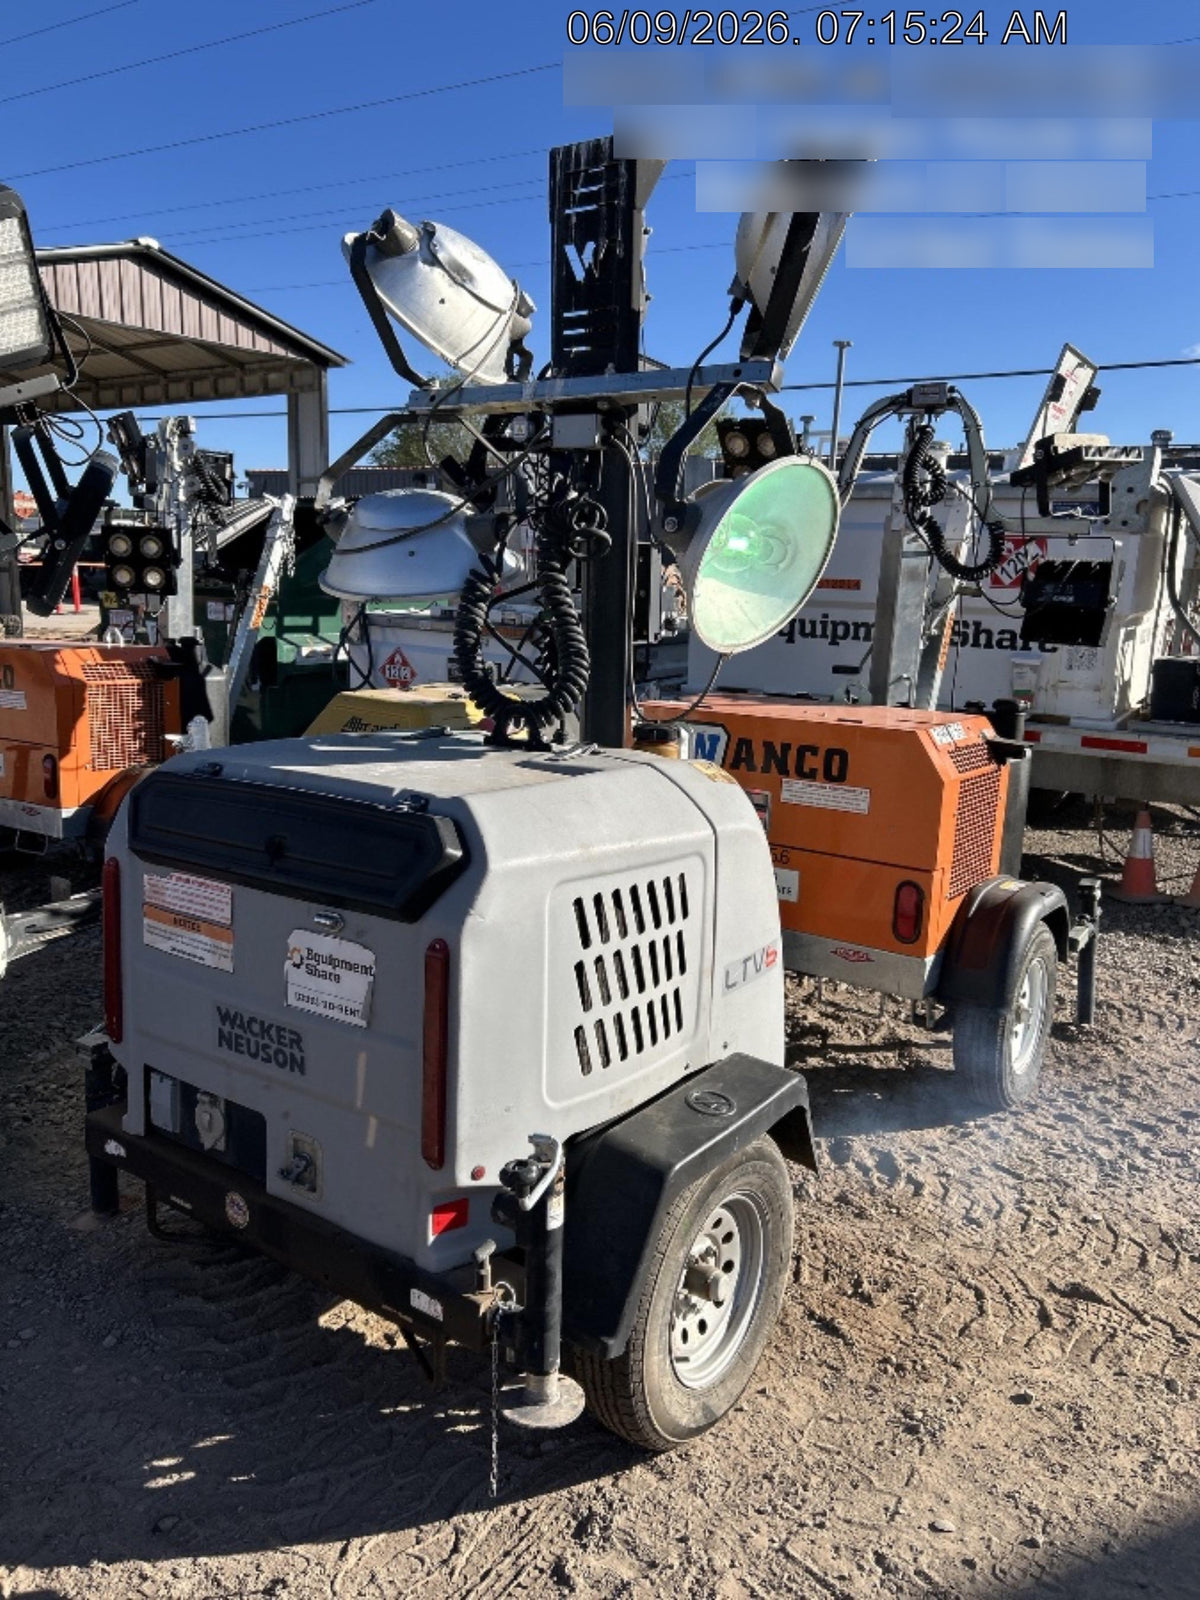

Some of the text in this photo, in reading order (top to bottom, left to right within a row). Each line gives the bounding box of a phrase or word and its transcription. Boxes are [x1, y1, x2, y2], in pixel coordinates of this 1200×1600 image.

[305, 947, 374, 977] Equipment
[305, 963, 340, 984] Share
[216, 1005, 304, 1053] WACKER
[217, 1027, 306, 1076] NEUSON
